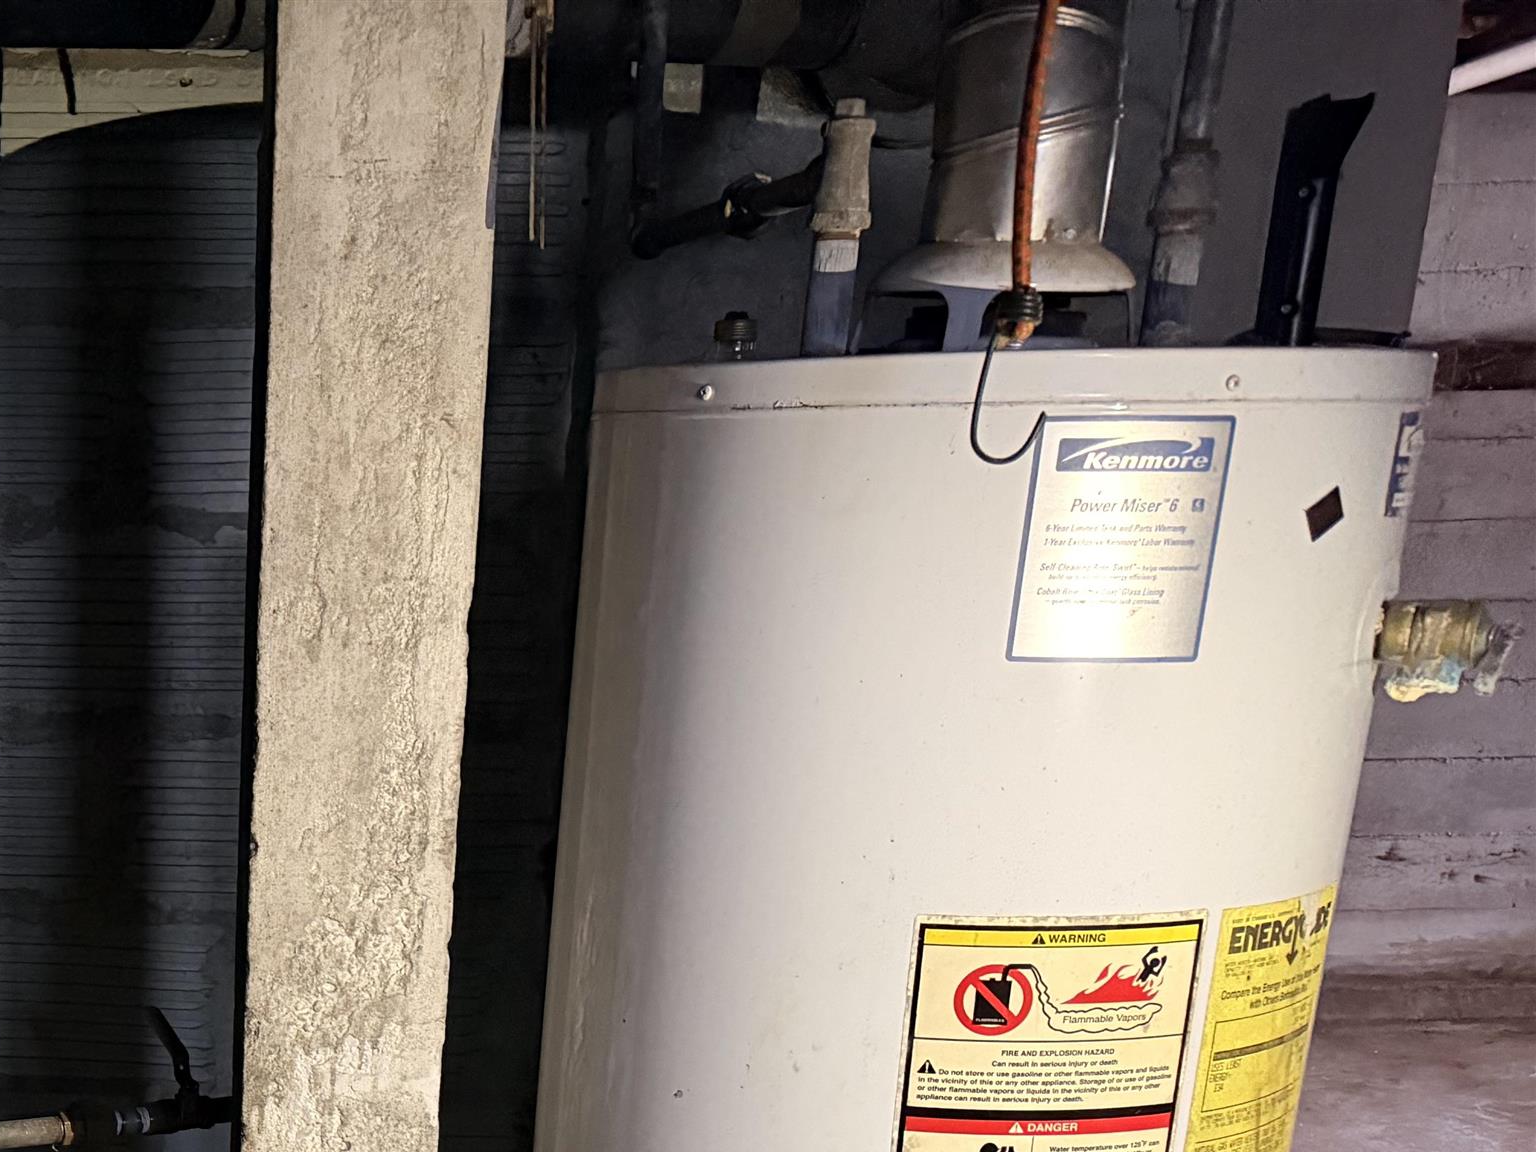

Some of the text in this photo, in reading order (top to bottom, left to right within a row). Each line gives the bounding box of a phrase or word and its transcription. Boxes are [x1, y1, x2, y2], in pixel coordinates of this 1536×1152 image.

[1083, 452, 1208, 469] Kenmore
[1070, 499, 1116, 512] Power
[1121, 499, 1162, 512] Miser
[1049, 934, 1106, 943] WARNING
[1063, 1014, 1146, 1024] Flammable Vapors
[1028, 1122, 1078, 1132] DANGER
